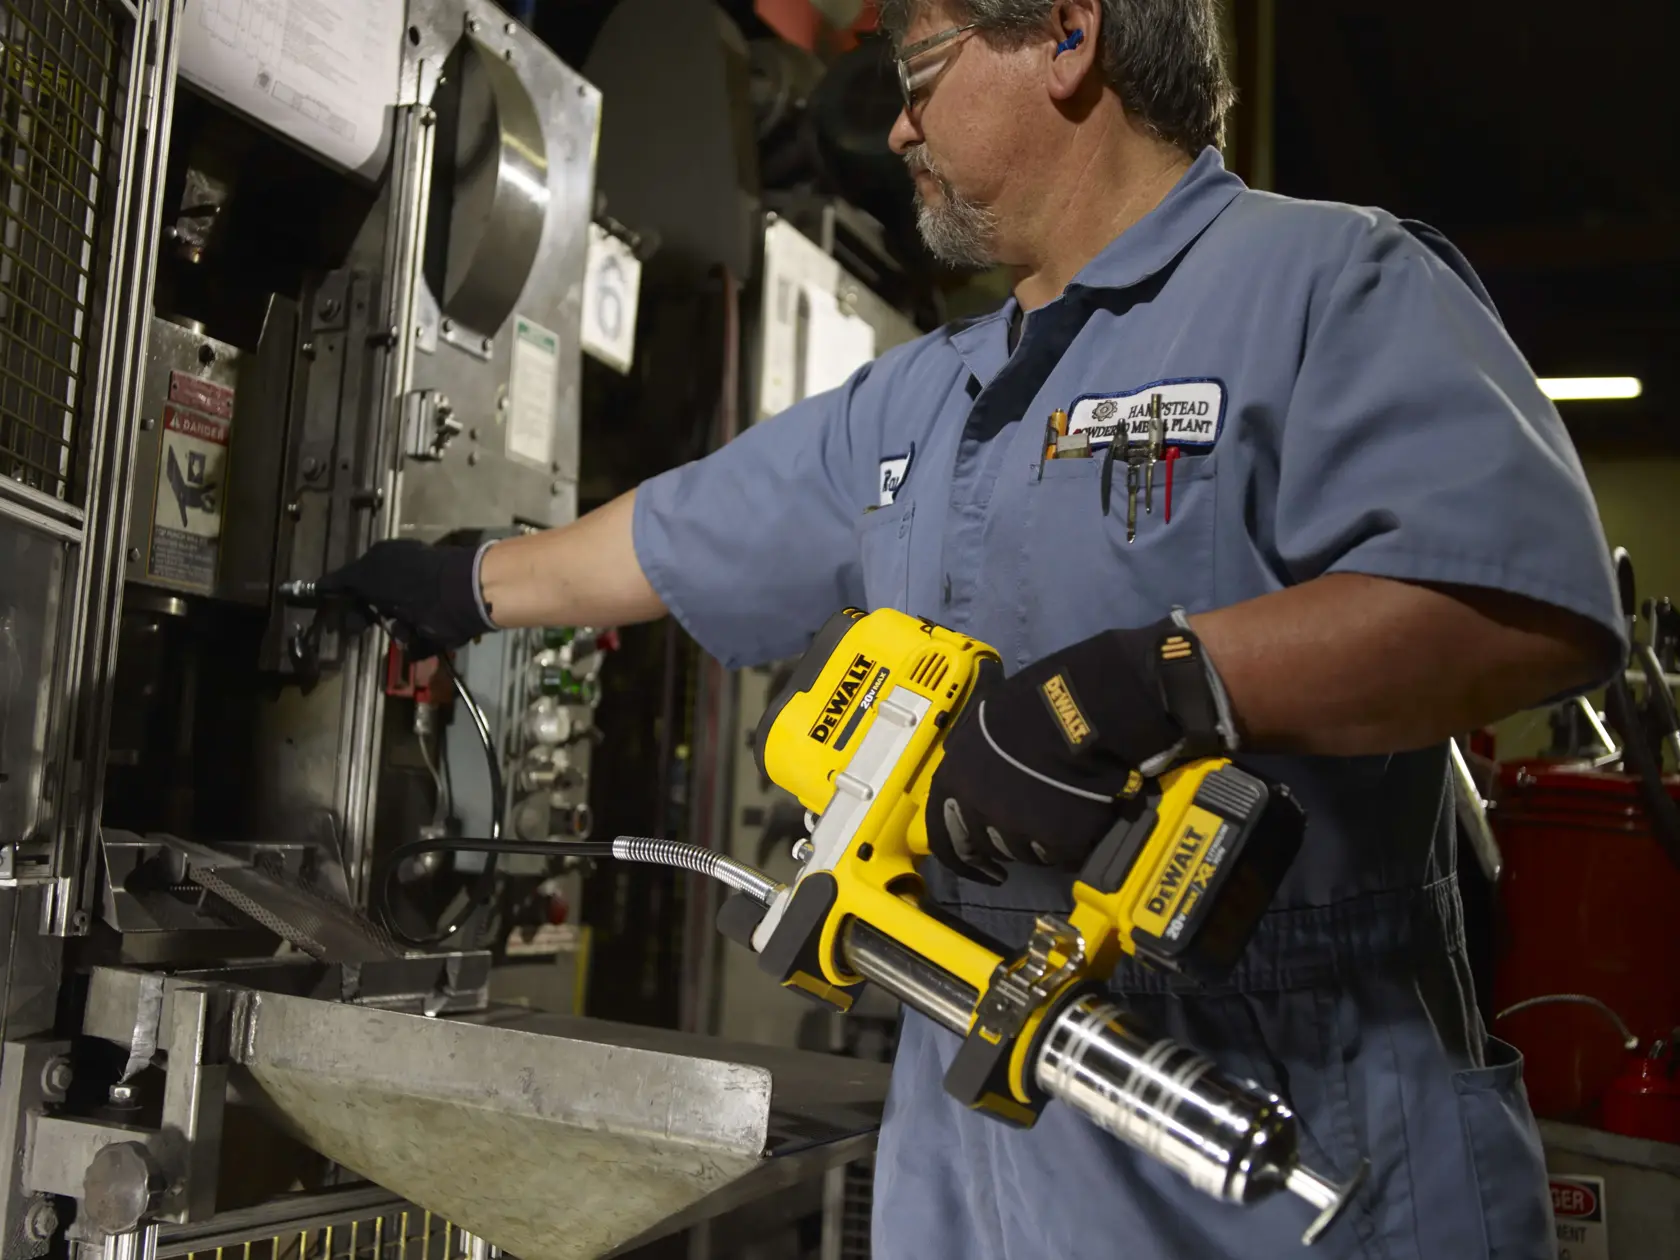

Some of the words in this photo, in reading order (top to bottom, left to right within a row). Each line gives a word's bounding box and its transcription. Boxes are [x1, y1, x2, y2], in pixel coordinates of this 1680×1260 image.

[183, 419, 224, 440] DANGER
[1171, 418, 1213, 434] PLANT
[874, 672, 887, 690] MAX
[809, 654, 875, 744] DEWALT
[1147, 826, 1204, 915] DEWALT
[1193, 862, 1217, 888] XR
